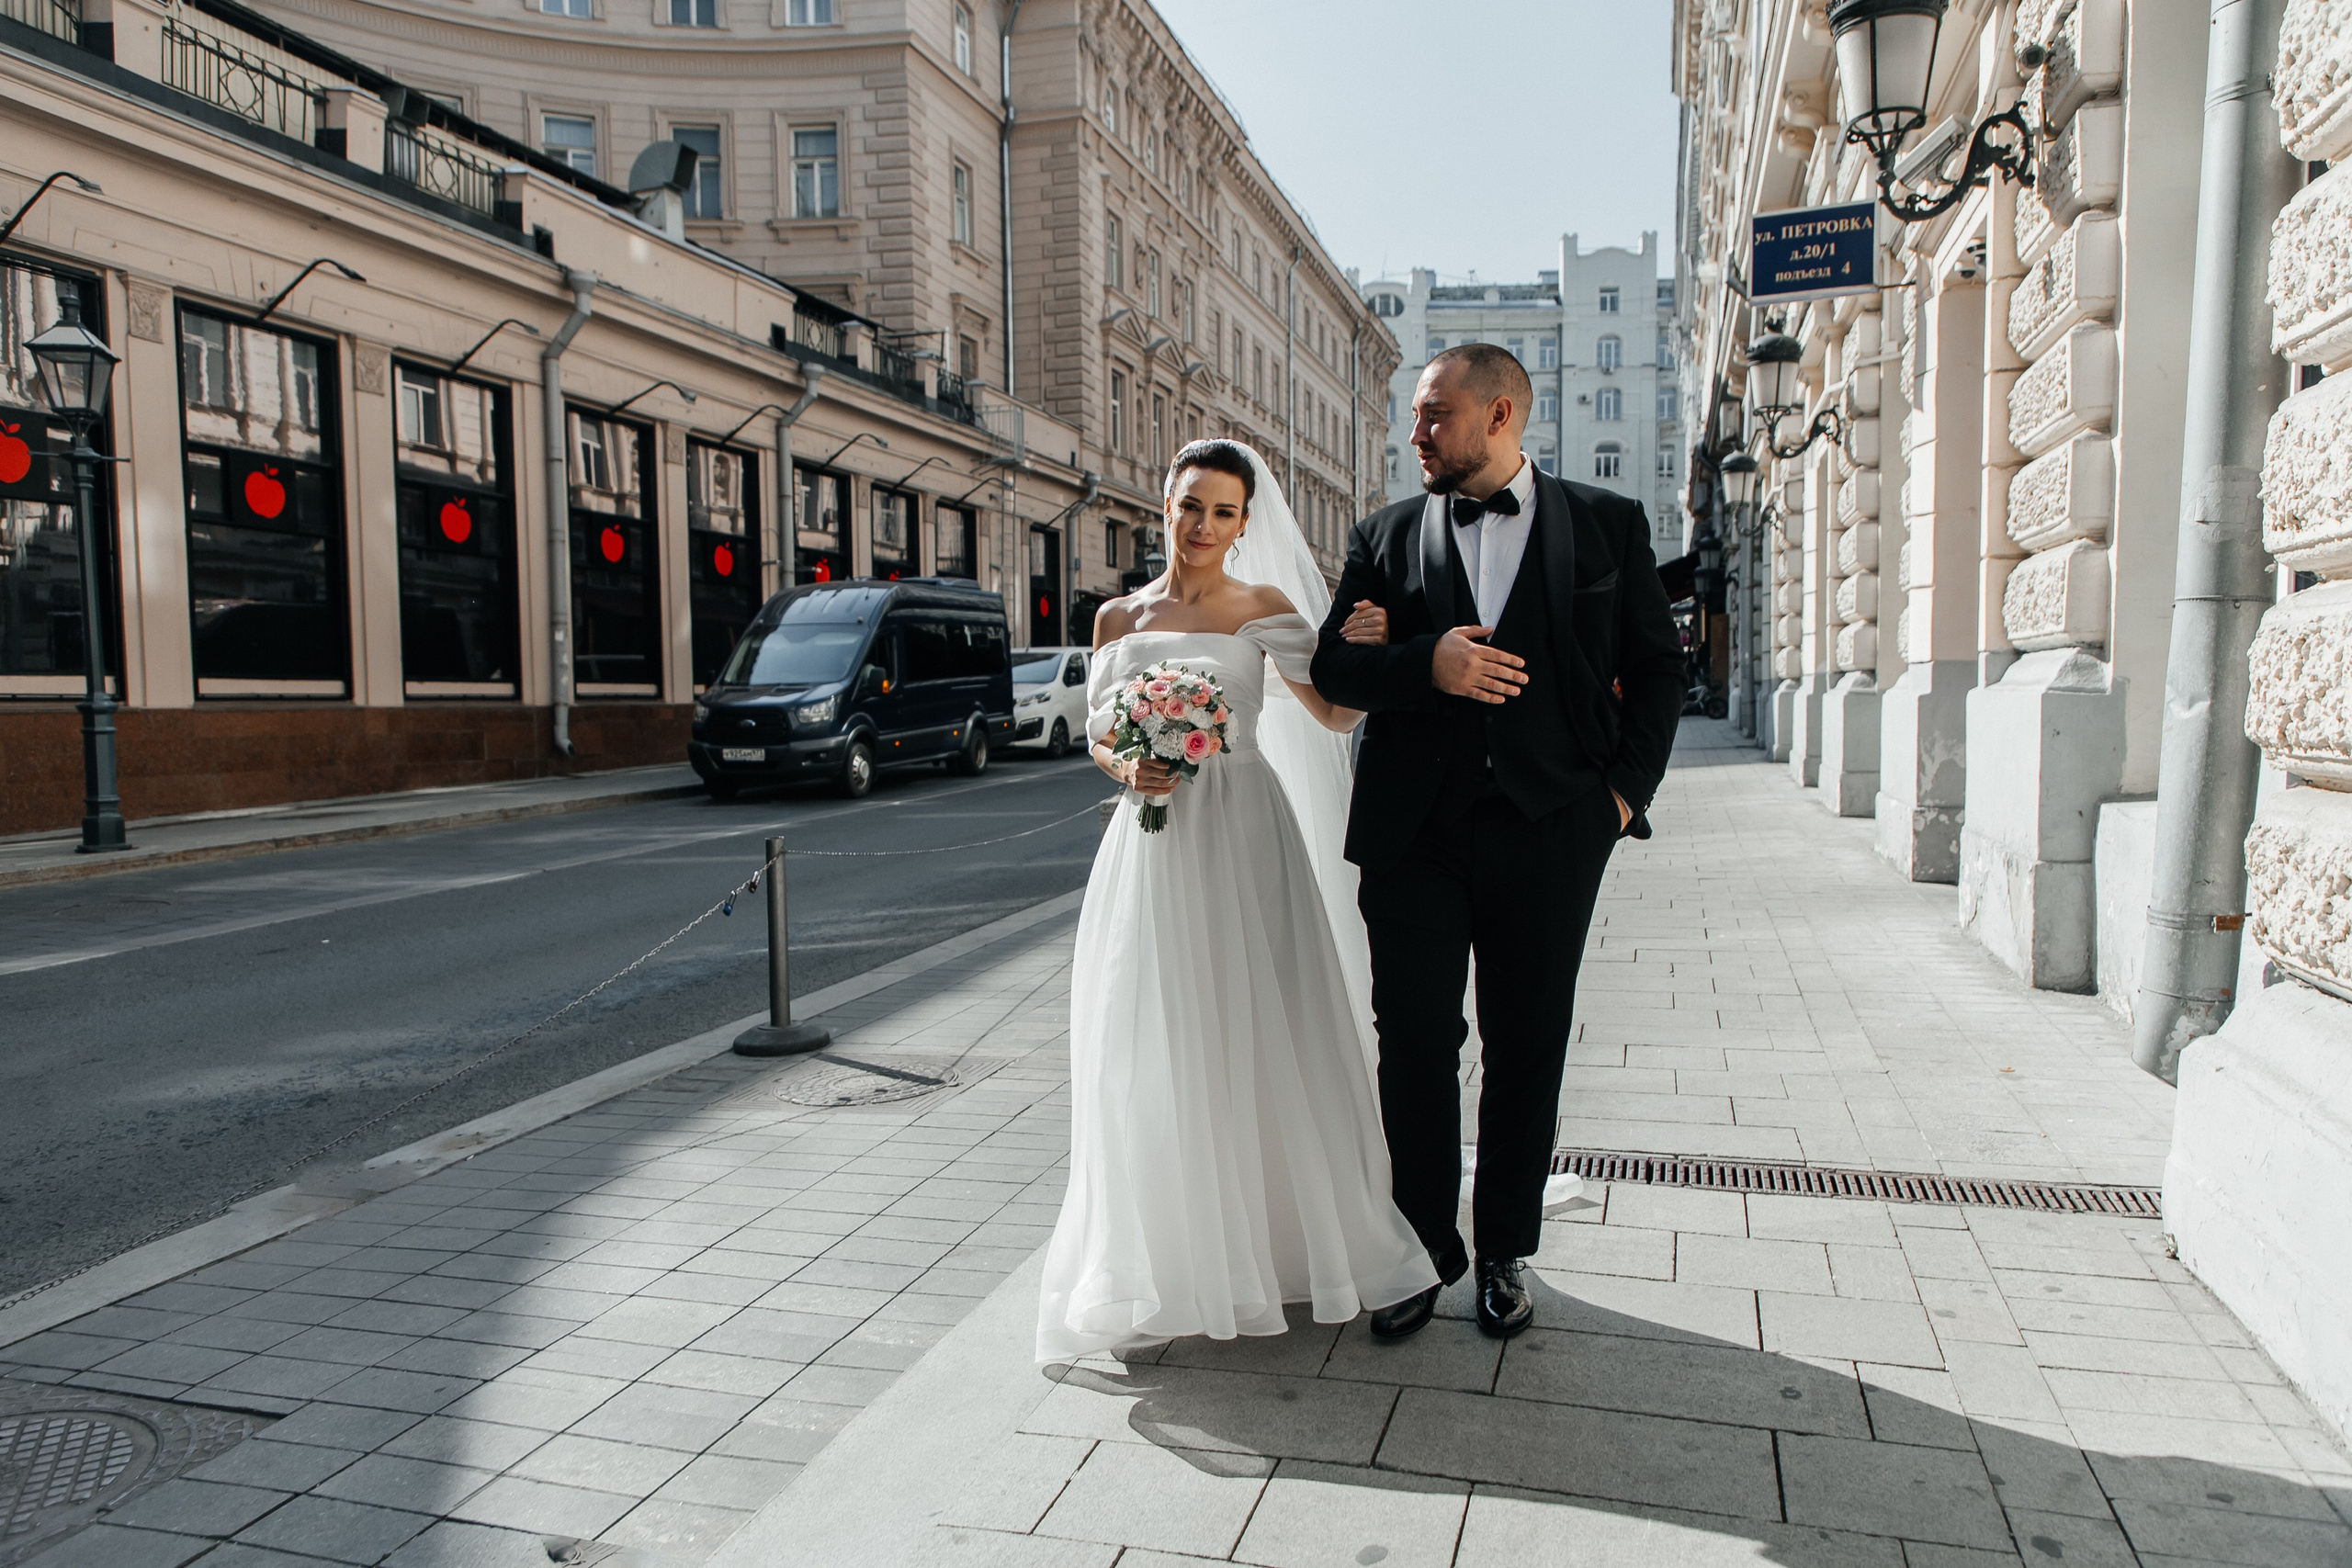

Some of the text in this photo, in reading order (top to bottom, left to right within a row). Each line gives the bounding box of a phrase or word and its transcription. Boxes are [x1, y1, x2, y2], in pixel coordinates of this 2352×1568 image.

[1755, 216, 1872, 245] ул. ПЕТРОВКА
[1790, 242, 1836, 261] д.20/1
[1775, 261, 1851, 283] подъезд 4
